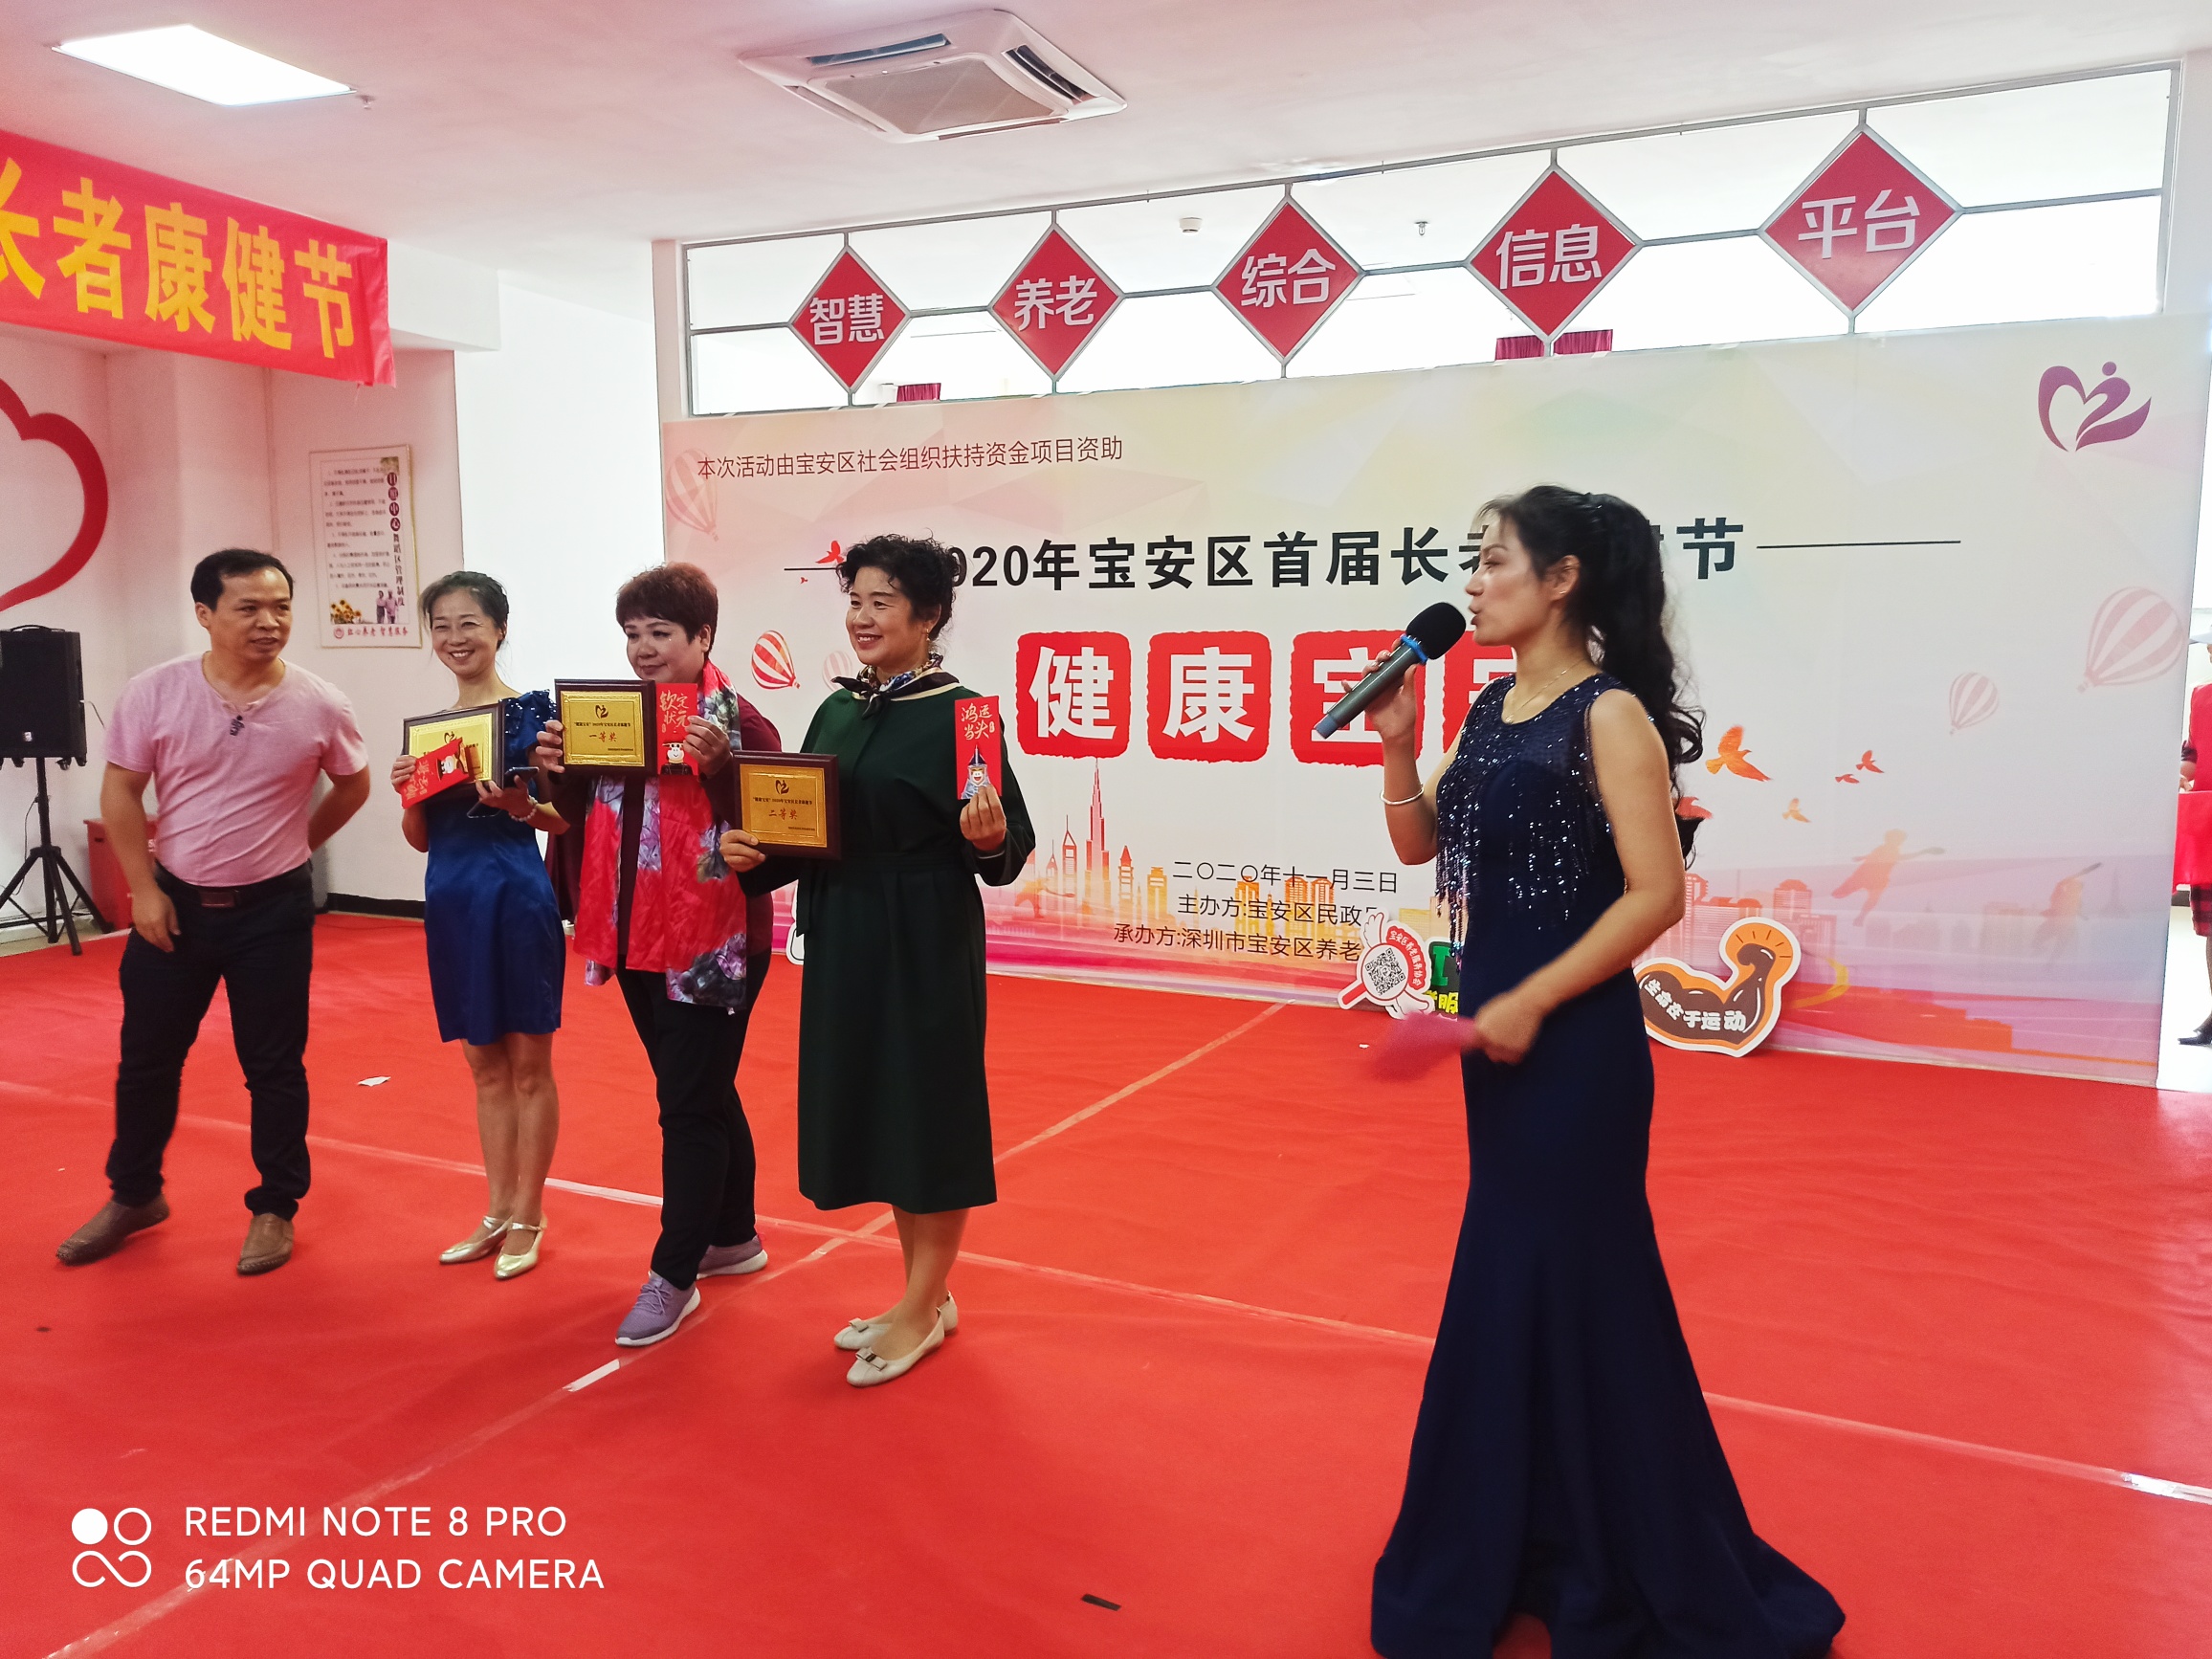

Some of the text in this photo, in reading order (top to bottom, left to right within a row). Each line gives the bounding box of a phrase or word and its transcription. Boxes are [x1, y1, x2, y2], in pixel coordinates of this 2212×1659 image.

[1797, 188, 1921, 259] 平台
[1241, 248, 1337, 308] 综合
[1494, 222, 1603, 290] 信息
[809, 293, 885, 345] 智慧
[1014, 276, 1097, 332] 养老
[697, 435, 1123, 480] 本次活动由宝安区社会组织扶持资金项目资助
[961, 702, 992, 723] 鸿运
[964, 719, 989, 741] 当头
[589, 731, 617, 743] 一等奖
[768, 807, 798, 820] 二等奖
[1177, 894, 1377, 926] 主办方:宝安区民政
[1644, 979, 1747, 1031] 生命在于运动
